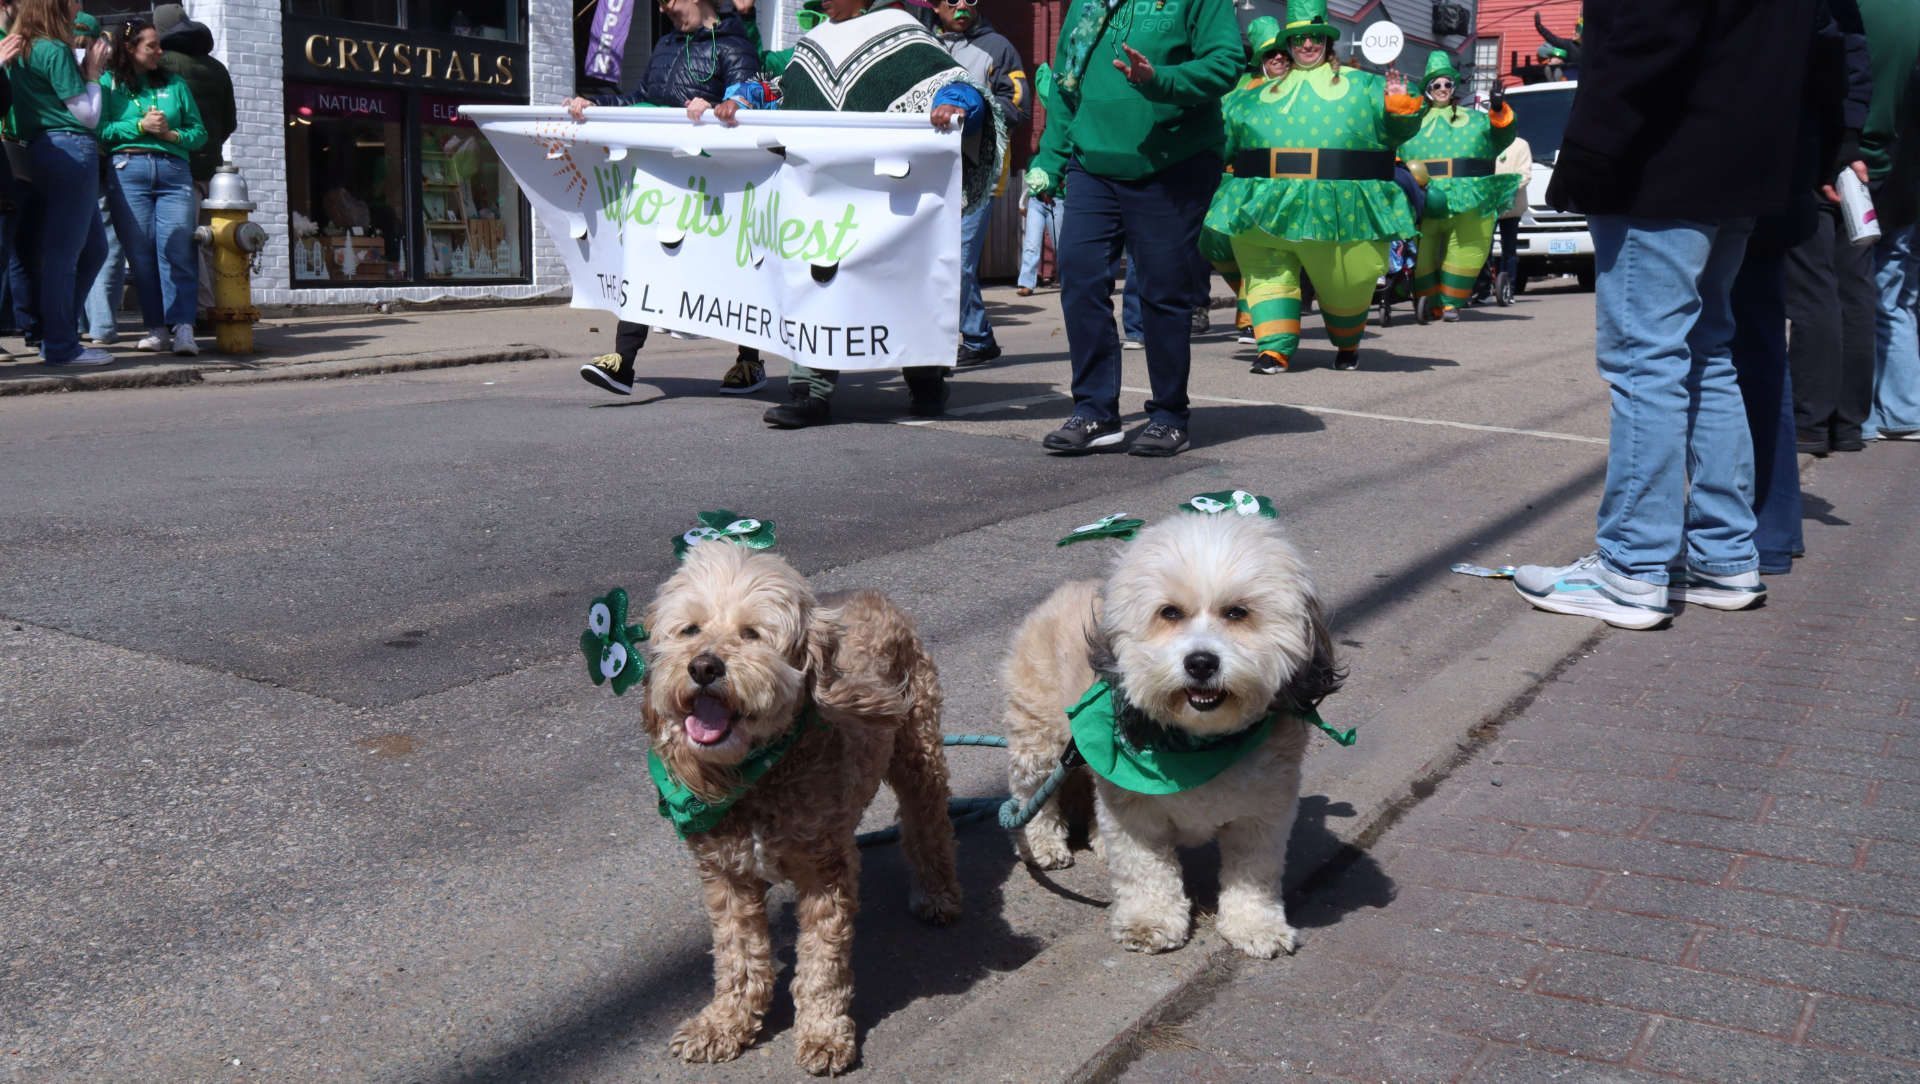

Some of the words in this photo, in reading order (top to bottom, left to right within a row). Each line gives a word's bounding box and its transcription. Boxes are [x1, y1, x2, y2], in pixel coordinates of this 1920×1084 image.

[305, 34, 513, 86] CRYSTALS
[593, 0, 624, 74] OPEN
[1365, 35, 1400, 48] OUR
[319, 94, 387, 115] NATURAL
[676, 175, 733, 237] its
[736, 181, 859, 268] fullest
[641, 284, 663, 315] L.
[679, 290, 772, 339] MAHER
[779, 314, 890, 357] CENTER
